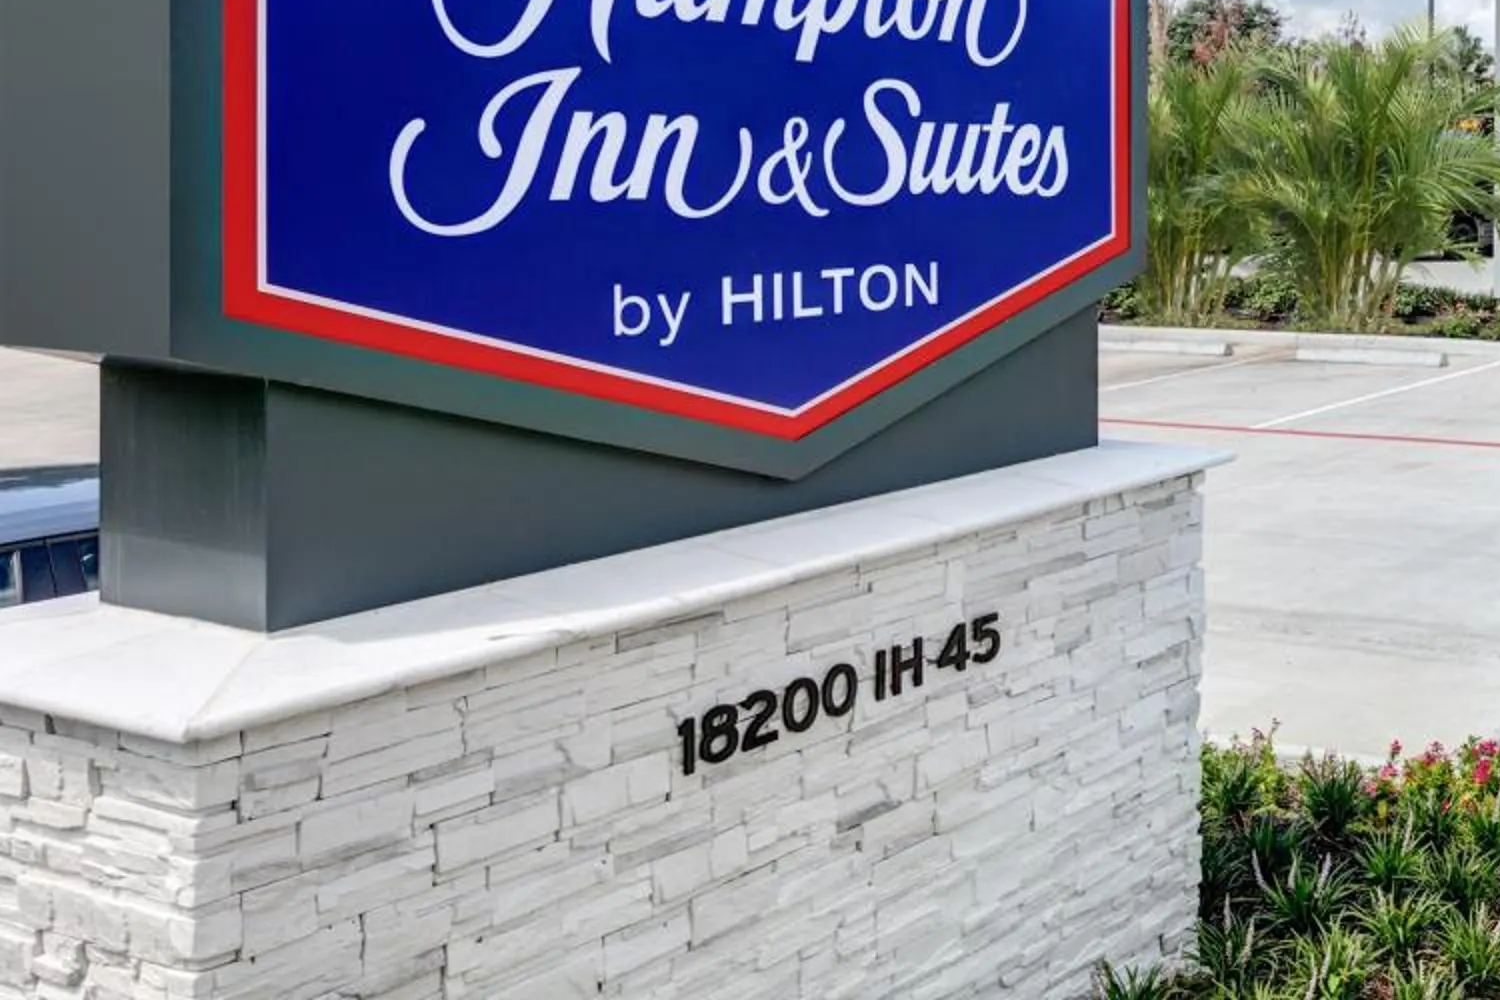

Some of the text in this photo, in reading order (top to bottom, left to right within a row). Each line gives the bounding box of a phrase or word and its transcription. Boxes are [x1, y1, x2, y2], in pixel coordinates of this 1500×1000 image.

[389, 66, 1069, 237] Inn & Suites
[613, 261, 939, 346] by HILTON
[676, 612, 1001, 777] 18200 IH 45
